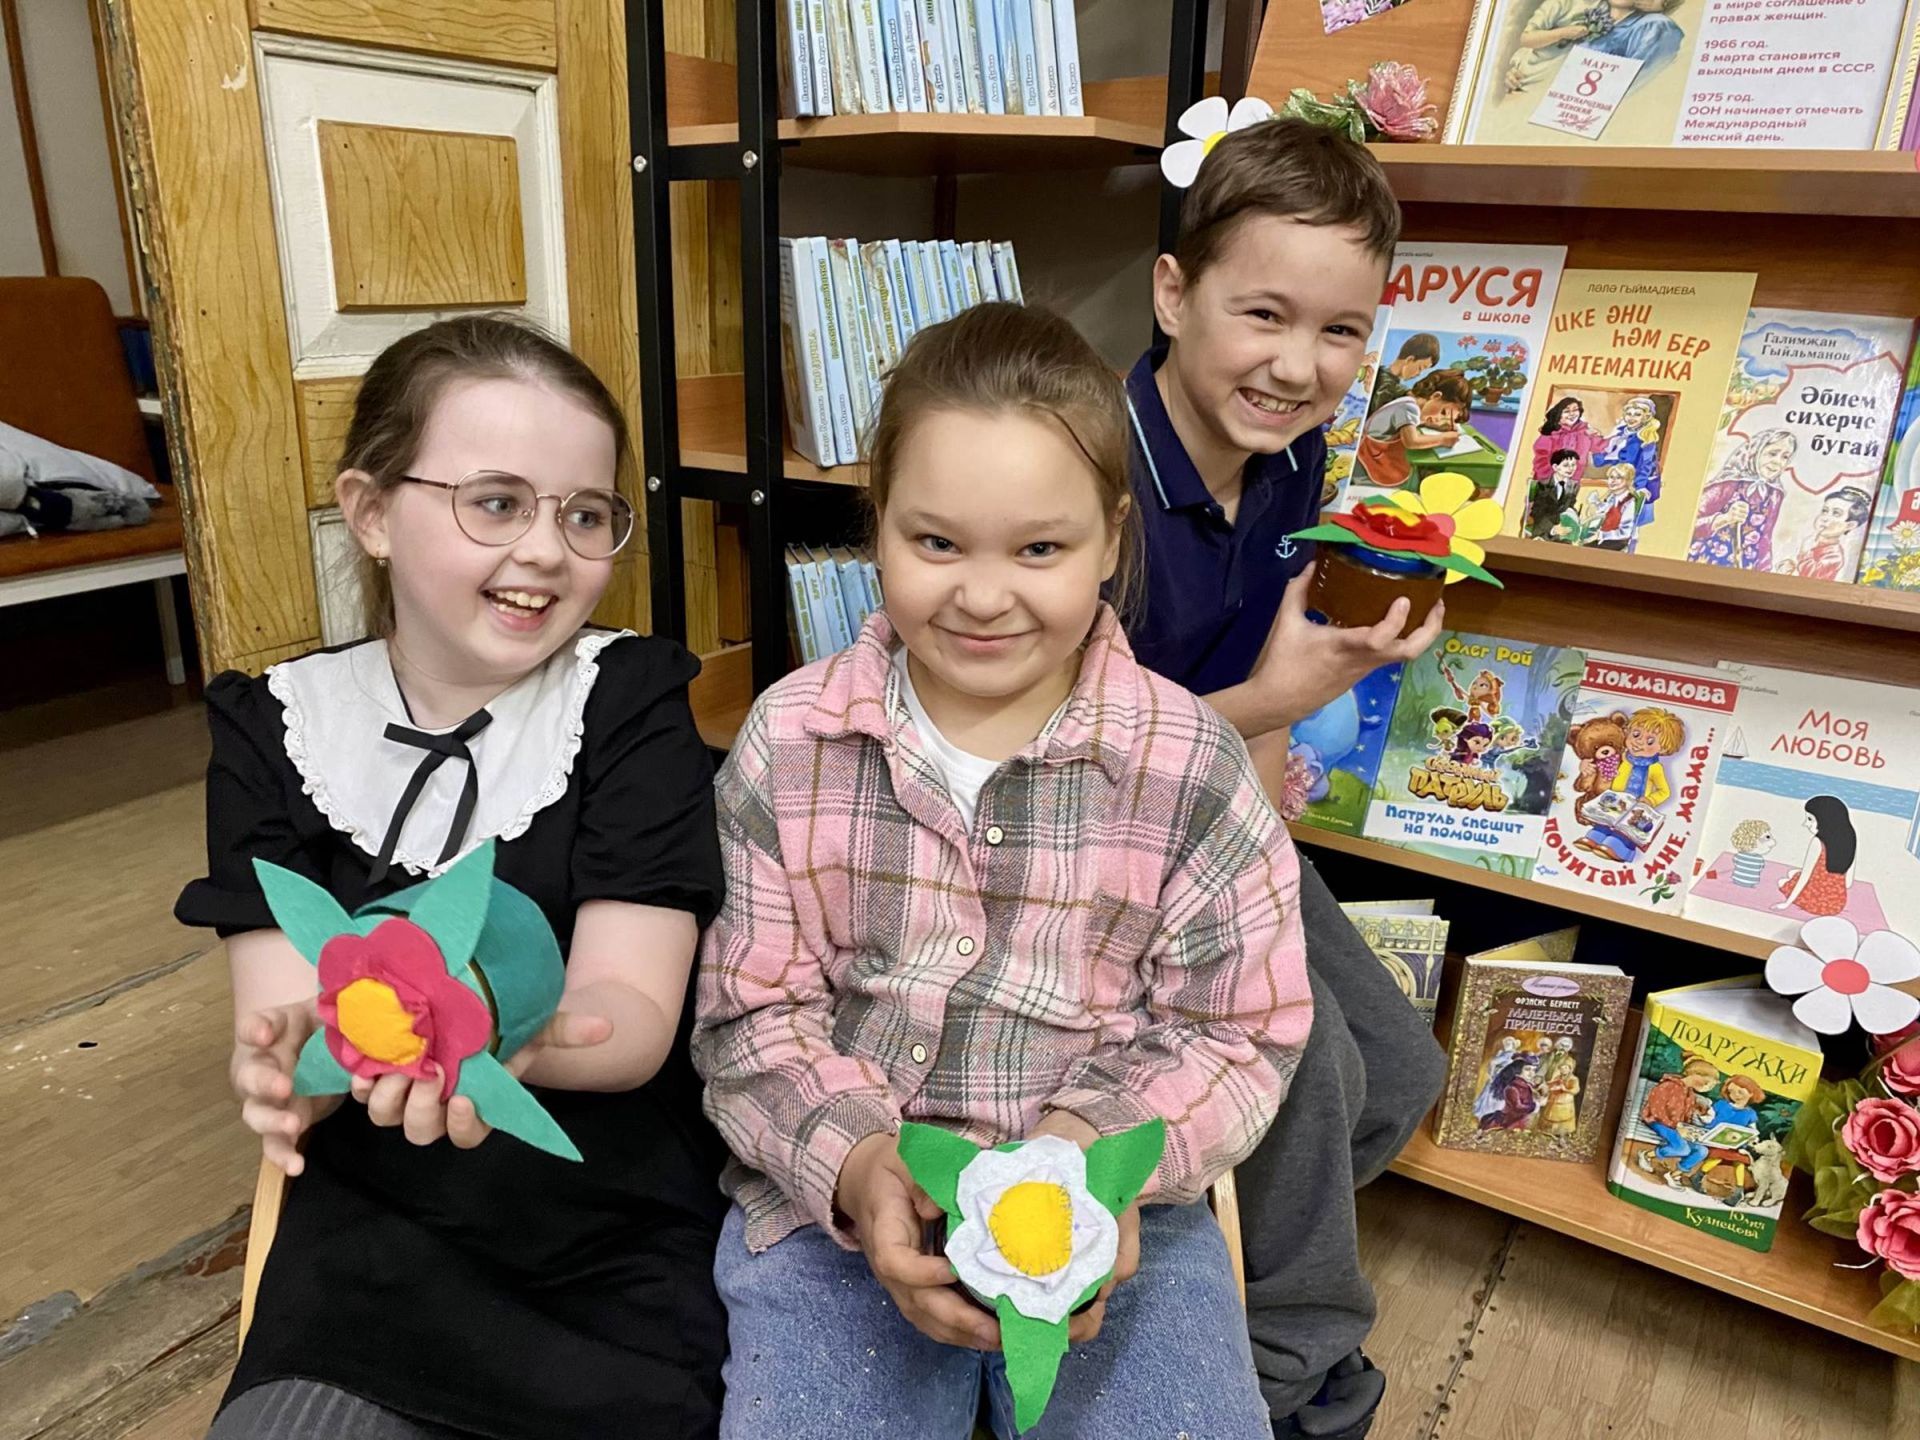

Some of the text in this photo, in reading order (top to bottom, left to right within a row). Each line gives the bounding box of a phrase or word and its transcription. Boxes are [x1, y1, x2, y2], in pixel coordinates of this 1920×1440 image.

[1712, 1, 1722, 10] в
[1726, 0, 1761, 13] мире
[1709, 11, 1827, 24] правах женщин.
[1704, 39, 1769, 49] 1966 год.
[1581, 57, 1620, 72] МАРТ
[1700, 52, 1841, 64] 8 марта становится
[1697, 63, 1876, 76] выходным днем в СССР.
[1576, 69, 1603, 97] 8
[1691, 92, 1755, 103] 1975 год.
[1688, 106, 1864, 115] ООН начинает отмечать
[1684, 118, 1807, 130] Международный
[1681, 132, 1785, 143] женский день.
[1392, 263, 1543, 308] АРУСЯ
[1620, 284, 1696, 295] ГЫЙМАДИЕВА
[1462, 311, 1531, 324] в школе
[1554, 303, 1652, 333] ИКЕ ӘНИ
[1667, 333, 1711, 358] БЕР
[1547, 354, 1692, 381] МАТЕМАТИКА
[1801, 386, 1876, 409] Әбием
[1811, 434, 1879, 457] бугай
[1403, 822, 1500, 846] на помощь
[1507, 1008, 1584, 1023] МАЛЕНЬКАЯ
[1503, 1018, 1581, 1035] ПРИНЦЕССА
[1669, 1018, 1809, 1084] ПОДРУЖКИ
[1685, 1207, 1759, 1239] Кузнецова
[1729, 1209, 1766, 1230] Юлия
